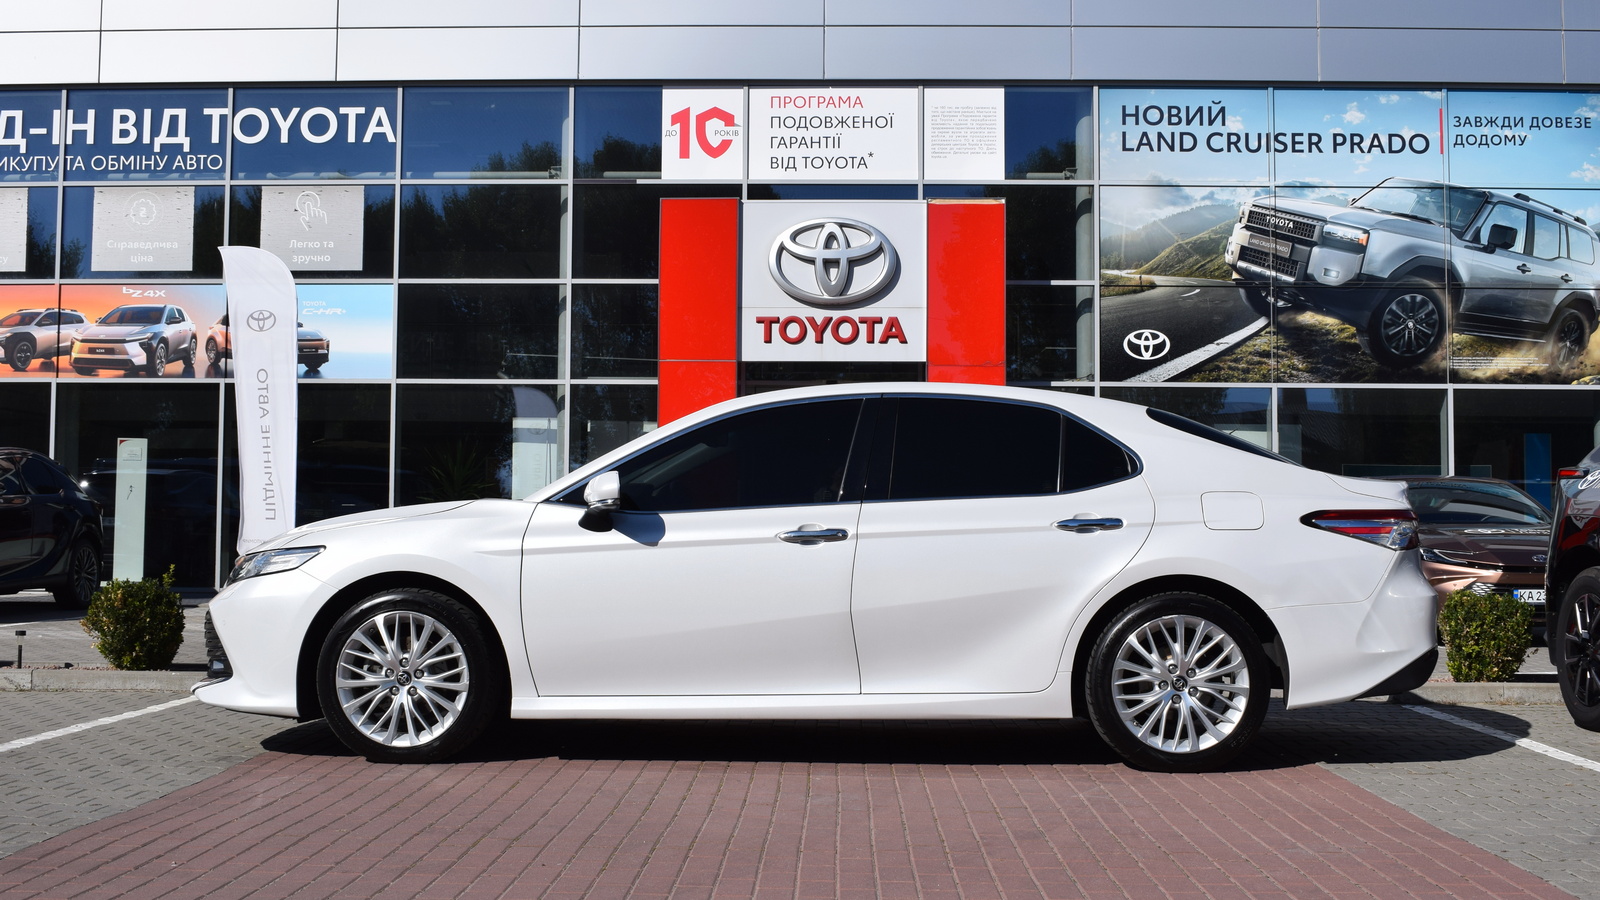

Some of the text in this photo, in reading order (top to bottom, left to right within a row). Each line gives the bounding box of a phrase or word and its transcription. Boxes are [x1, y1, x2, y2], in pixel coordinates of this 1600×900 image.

[770, 96, 864, 109] ПРОГРАМА
[1121, 100, 1226, 127] НОВИЙ
[112, 108, 190, 152] ВІД
[203, 106, 397, 144] TOYOTA
[770, 112, 895, 131] ПОДОВЖЕНОЇ
[1453, 115, 1592, 130] ЗАВЖДИ ДОВЕЗЕ
[770, 132, 842, 149] ГАРАНТІЇ
[1121, 131, 1430, 155] LAND CRUISER PRADO
[1453, 133, 1528, 148] ДОДОМУ
[65, 156, 86, 171] ТА
[91, 155, 168, 171] ОБМІНУ
[172, 154, 223, 170] АВТО
[770, 156, 797, 172] ВІД
[1266, 216, 1293, 228] TOYOTA
[106, 239, 179, 251] Справедлива
[289, 239, 335, 249] Легко та
[130, 253, 154, 264] ціна
[292, 254, 331, 265] зручно
[755, 315, 908, 345] TOYOTA
